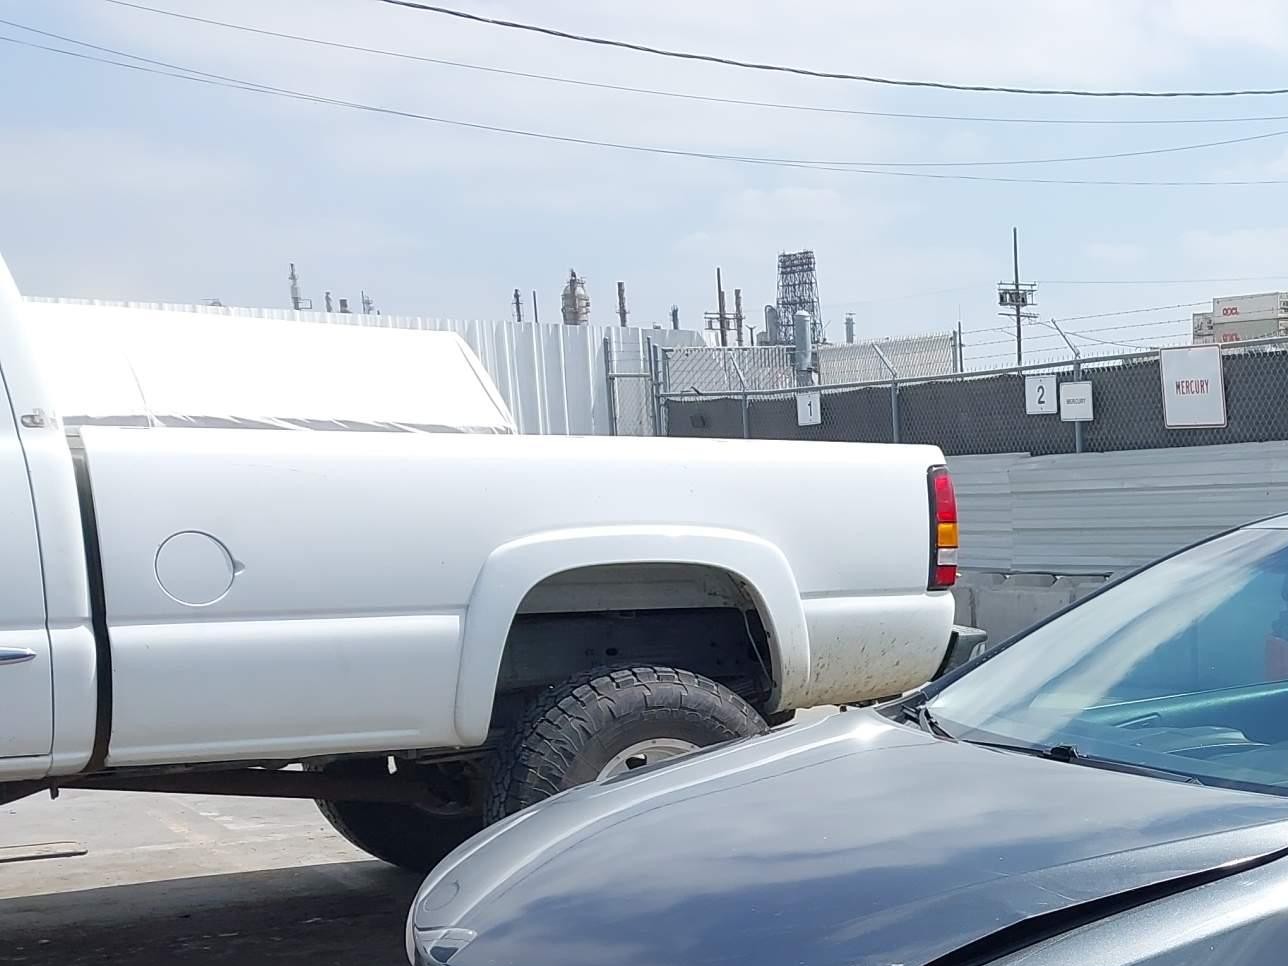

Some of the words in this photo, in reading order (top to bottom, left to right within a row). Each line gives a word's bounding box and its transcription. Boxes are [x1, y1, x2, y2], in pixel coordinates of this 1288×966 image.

[1037, 385, 1045, 405] 2
[1175, 378, 1209, 395] MERCURY
[807, 400, 813, 417] 1
